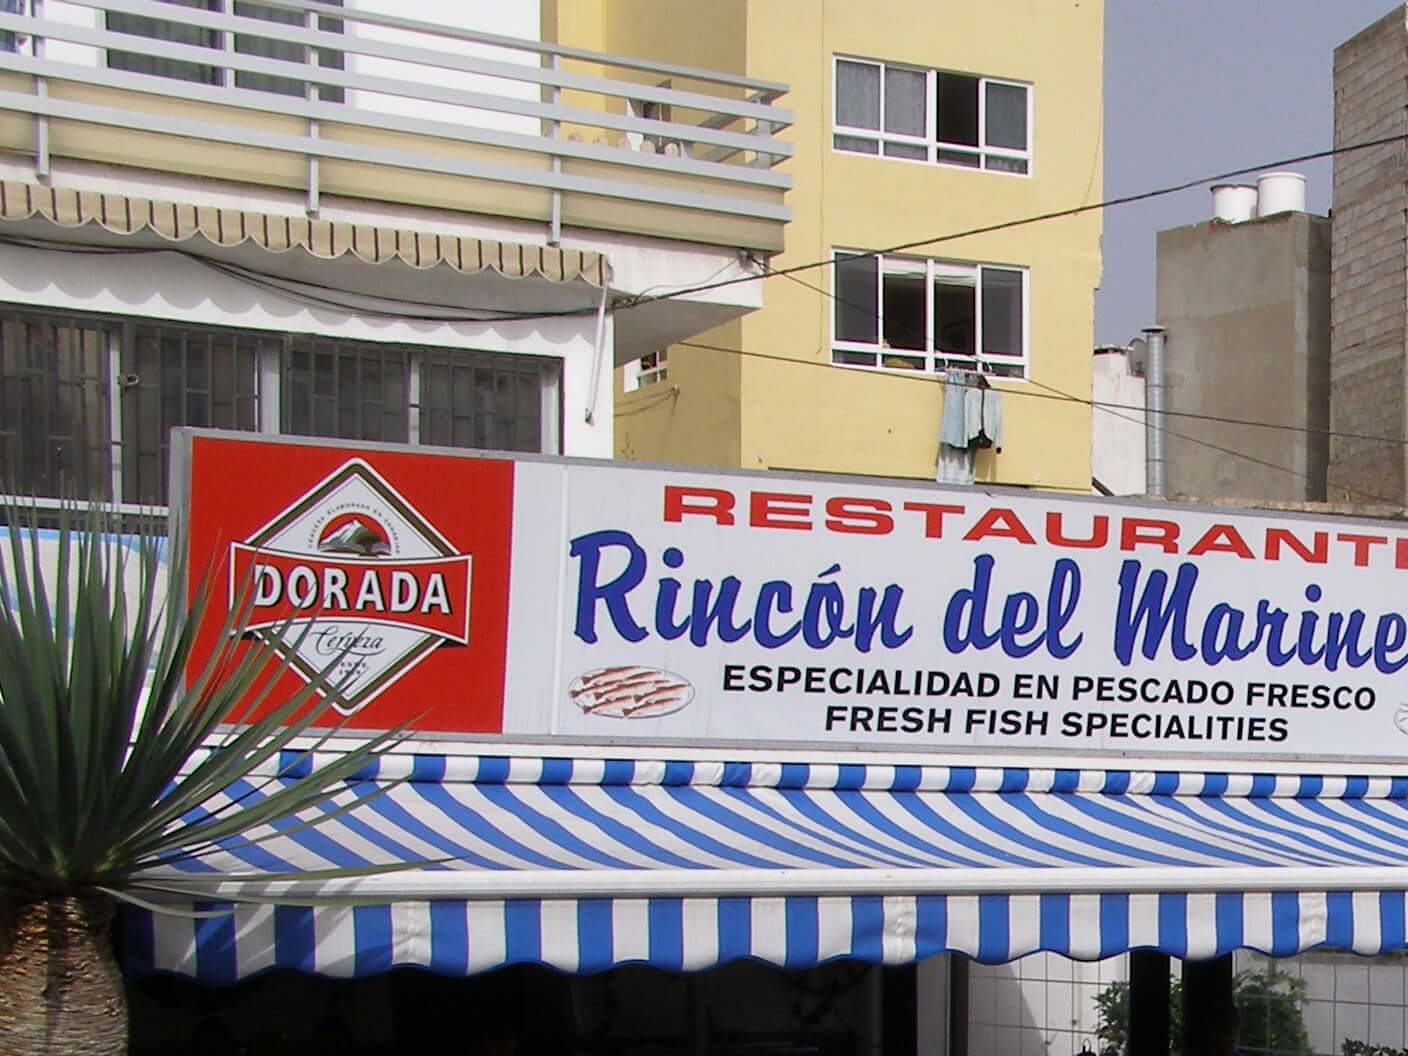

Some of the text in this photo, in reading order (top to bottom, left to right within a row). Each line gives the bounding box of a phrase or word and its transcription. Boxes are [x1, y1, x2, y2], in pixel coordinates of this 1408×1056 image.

[254, 564, 451, 615] DORADA
[569, 529, 913, 653] Rincón
[942, 553, 1083, 660] del
[723, 664, 1377, 711] ESPECIALIDAD EN PESCADO FRESCO
[825, 705, 1289, 743] FRESH FISH SPECIALITIES
